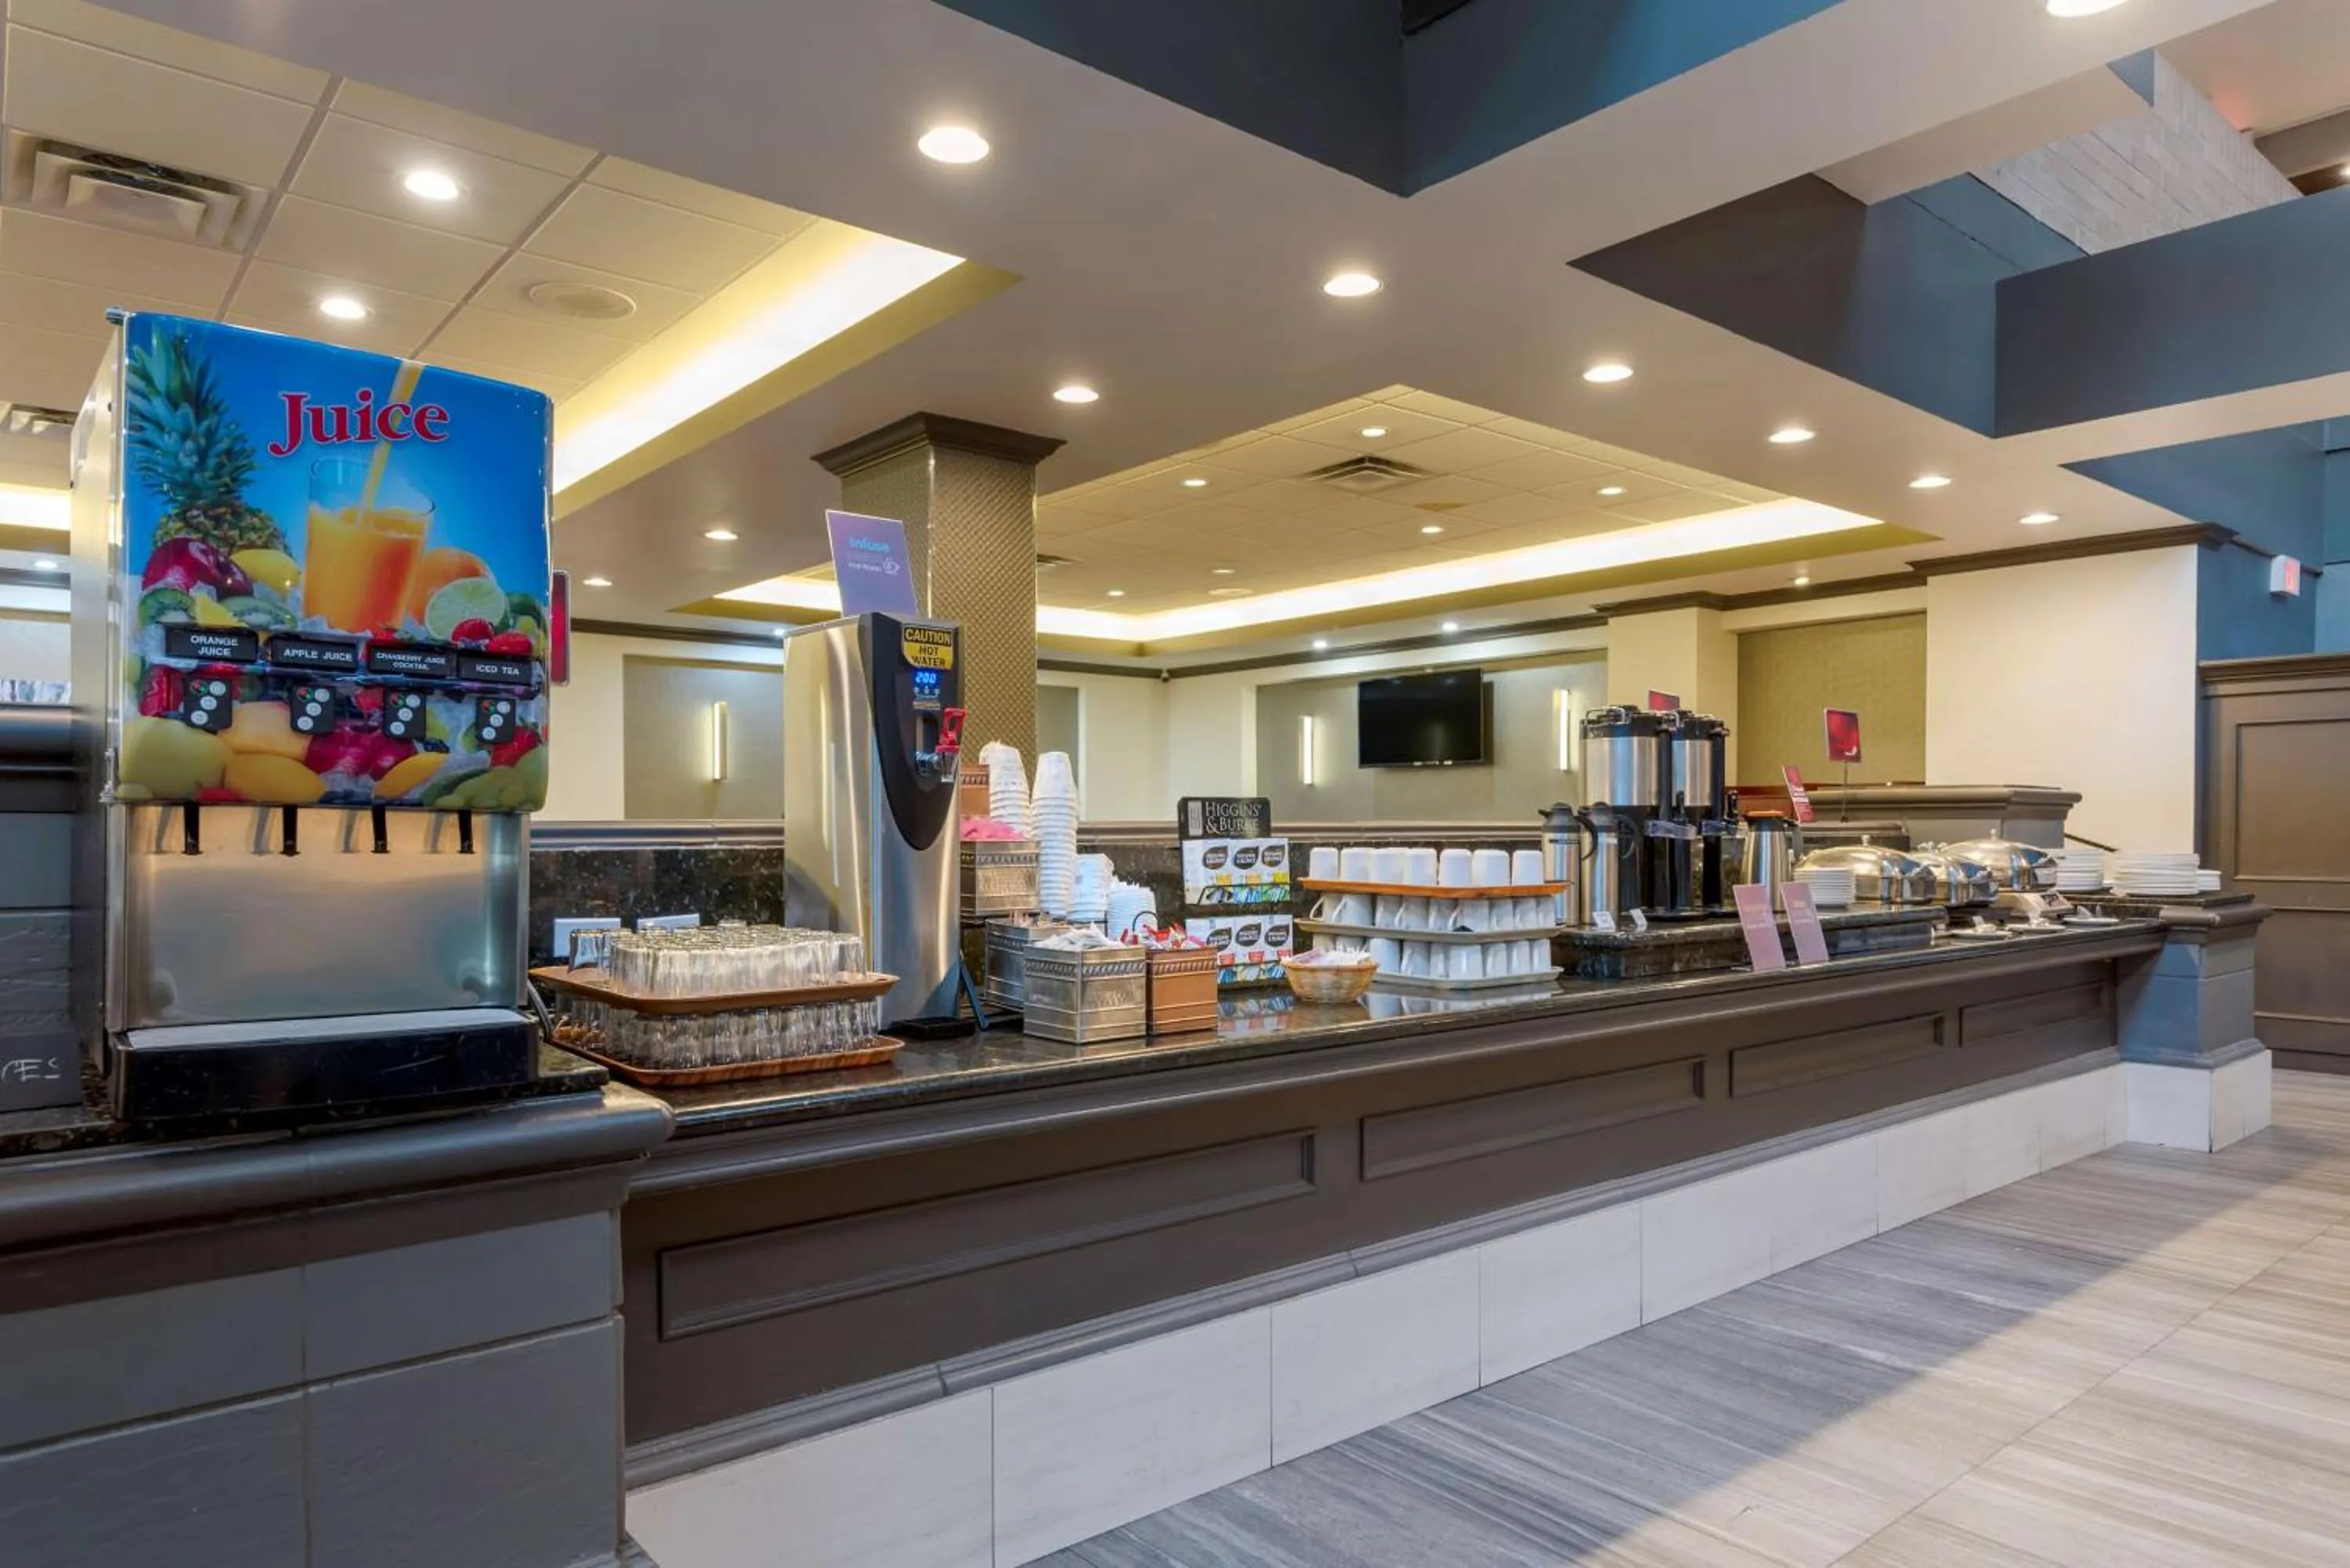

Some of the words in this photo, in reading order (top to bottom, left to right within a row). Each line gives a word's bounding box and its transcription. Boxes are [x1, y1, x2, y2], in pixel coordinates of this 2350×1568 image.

[268, 388, 450, 457] Juice
[190, 635, 238, 646] ORANGE
[905, 629, 950, 644] CAUTION
[198, 648, 231, 656] JUICE
[284, 649, 318, 659] APPLE
[323, 653, 352, 662] JUICE
[920, 646, 938, 656] HOT
[912, 656, 945, 667] WATER
[475, 663, 497, 674] ICED
[501, 666, 519, 675] TEA
[1206, 816, 1218, 834] &
